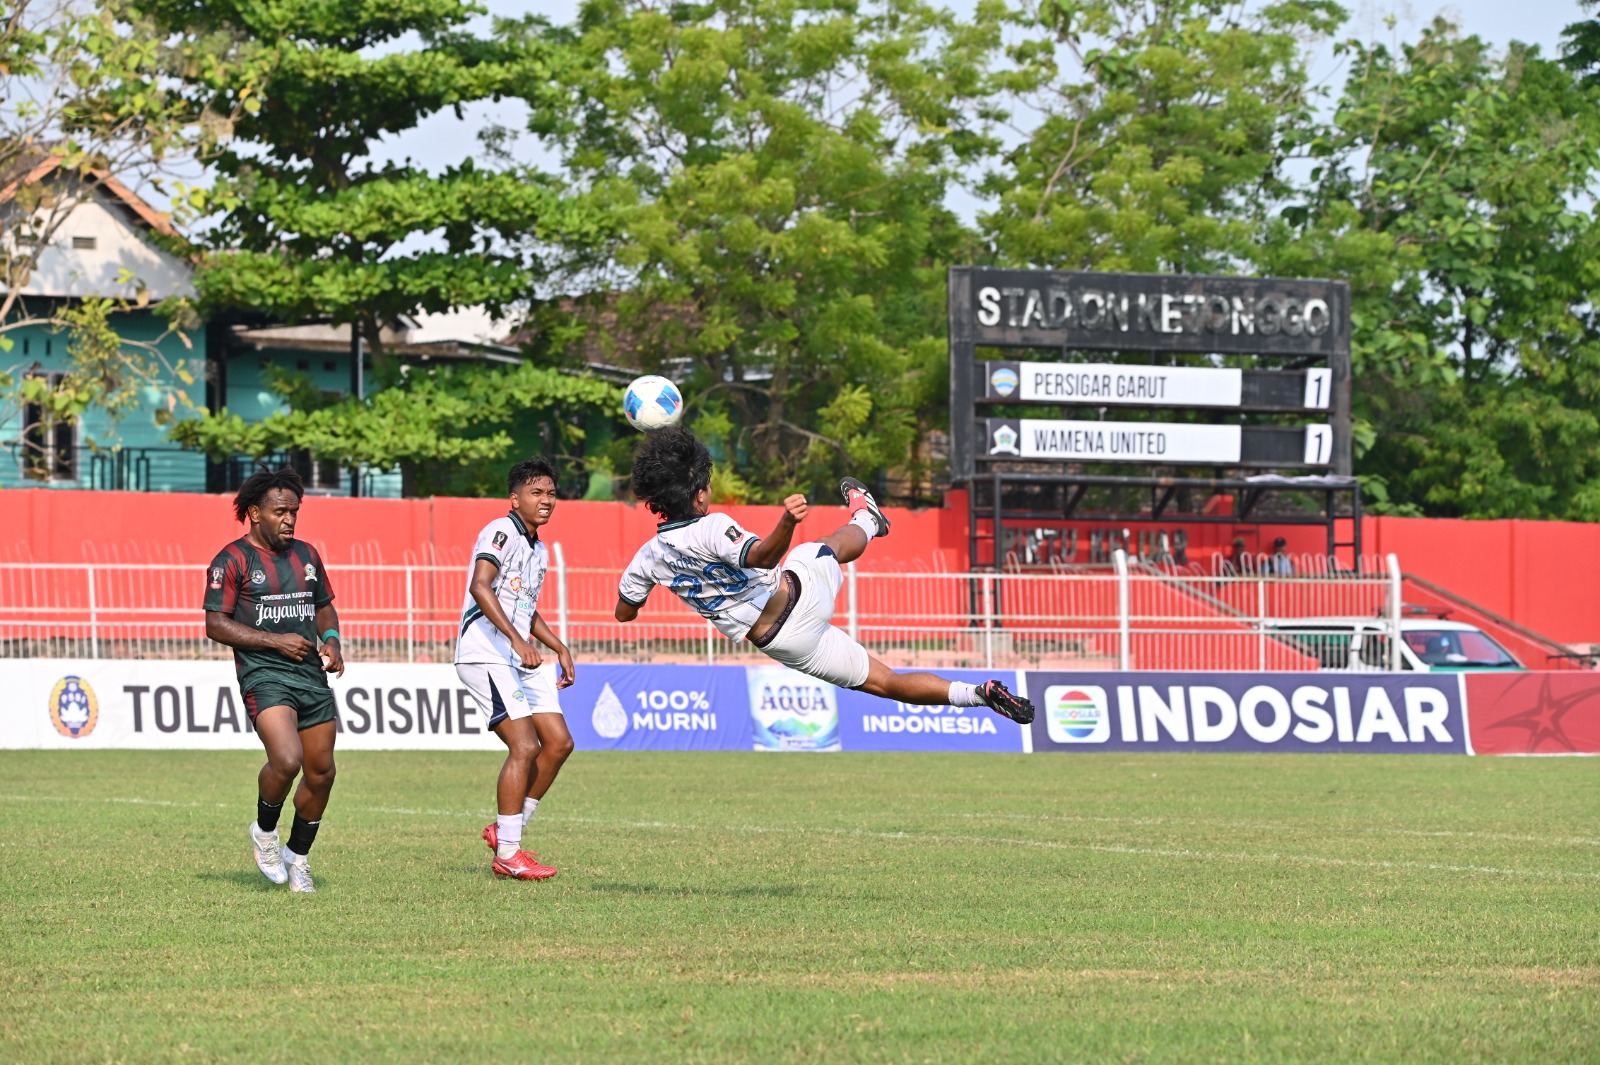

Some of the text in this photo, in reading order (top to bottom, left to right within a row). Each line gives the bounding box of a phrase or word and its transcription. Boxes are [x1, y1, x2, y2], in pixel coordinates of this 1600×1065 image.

[977, 286, 1330, 336] STADION KETONGGO
[1034, 373, 1167, 398] PERSIGAR GARUT
[1314, 375, 1323, 408] 1
[1034, 429, 1166, 455] WAMENA UNITED
[1315, 432, 1323, 464] 1
[123, 685, 254, 733] TOLA
[637, 690, 709, 710] 100%
[760, 685, 828, 716] AQUA
[1116, 685, 1454, 743] INDOSIAR
[633, 712, 717, 730] MURNI
[863, 714, 997, 734] INDONESIA
